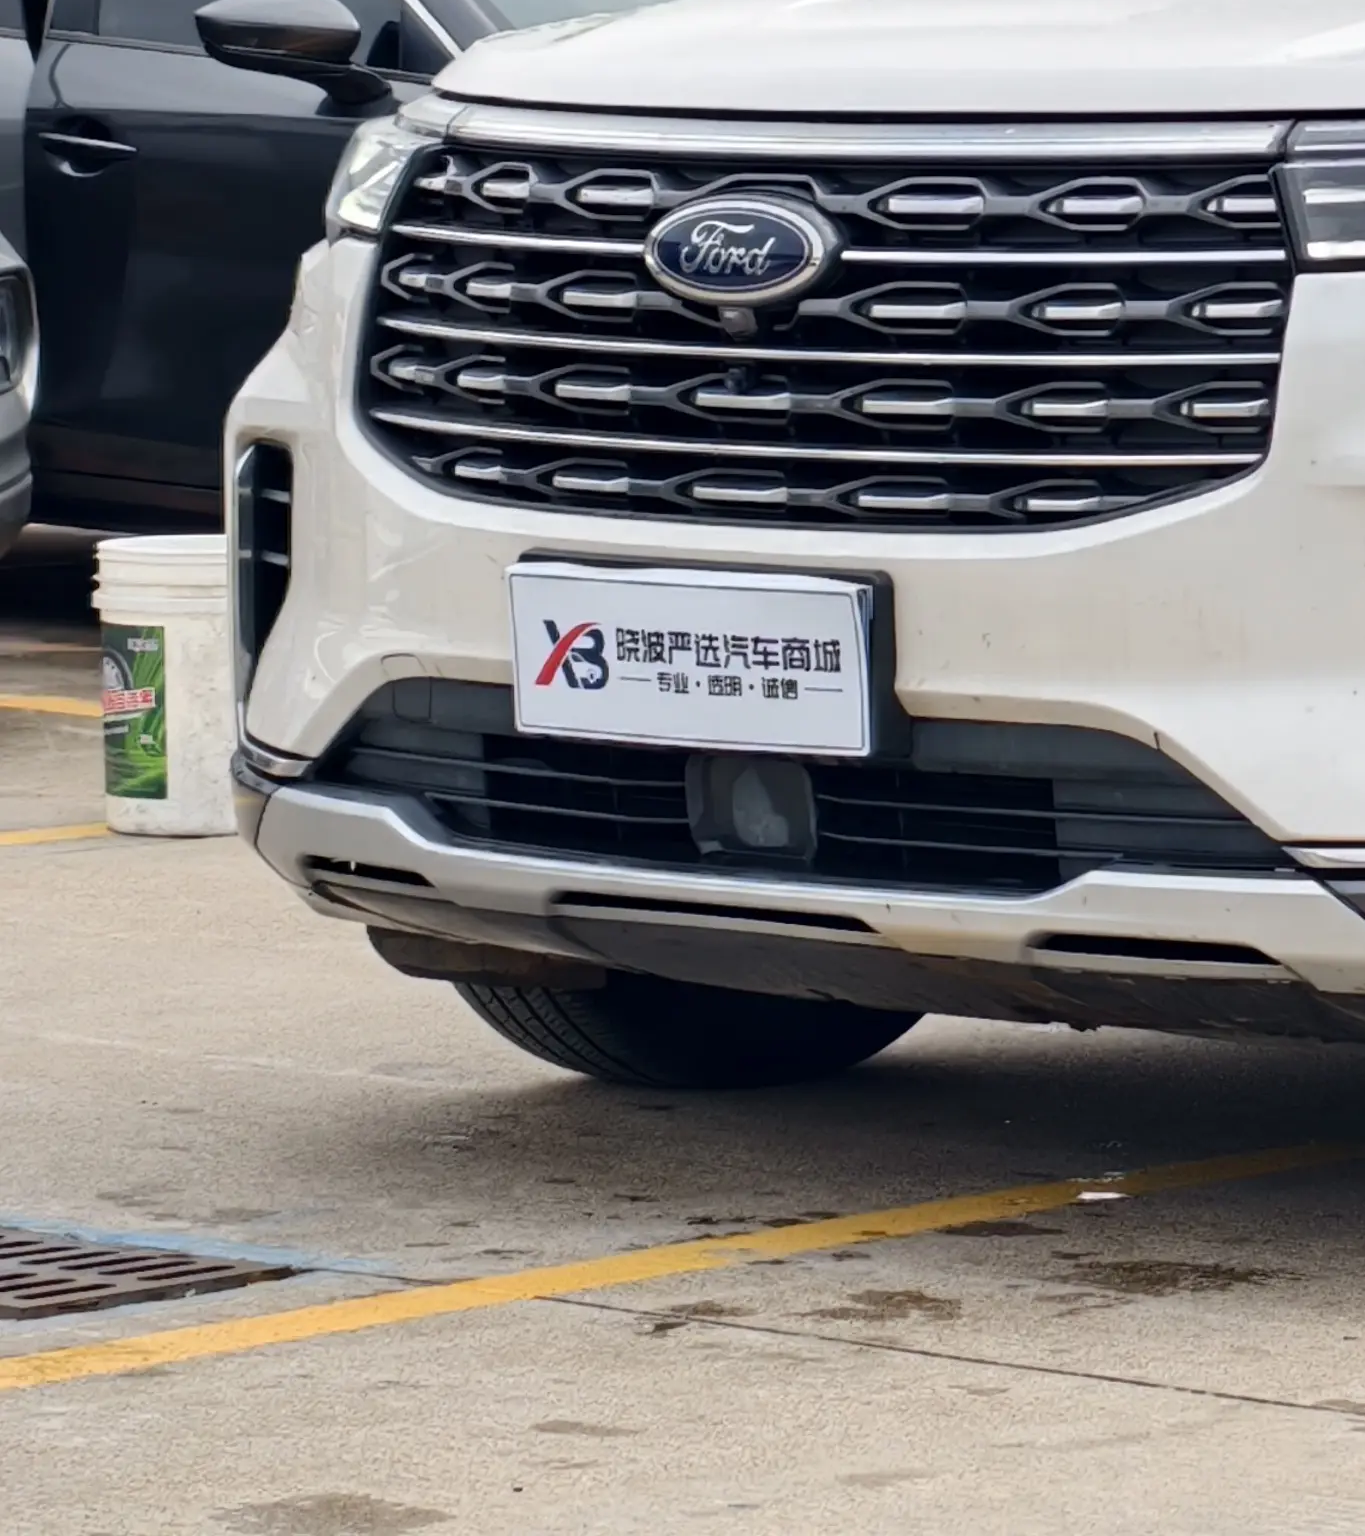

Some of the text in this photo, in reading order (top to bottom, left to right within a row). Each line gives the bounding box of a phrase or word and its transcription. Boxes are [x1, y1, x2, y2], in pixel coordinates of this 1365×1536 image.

[679, 219, 776, 276] Ford
[615, 626, 842, 674] 晓波严选汽车商城
